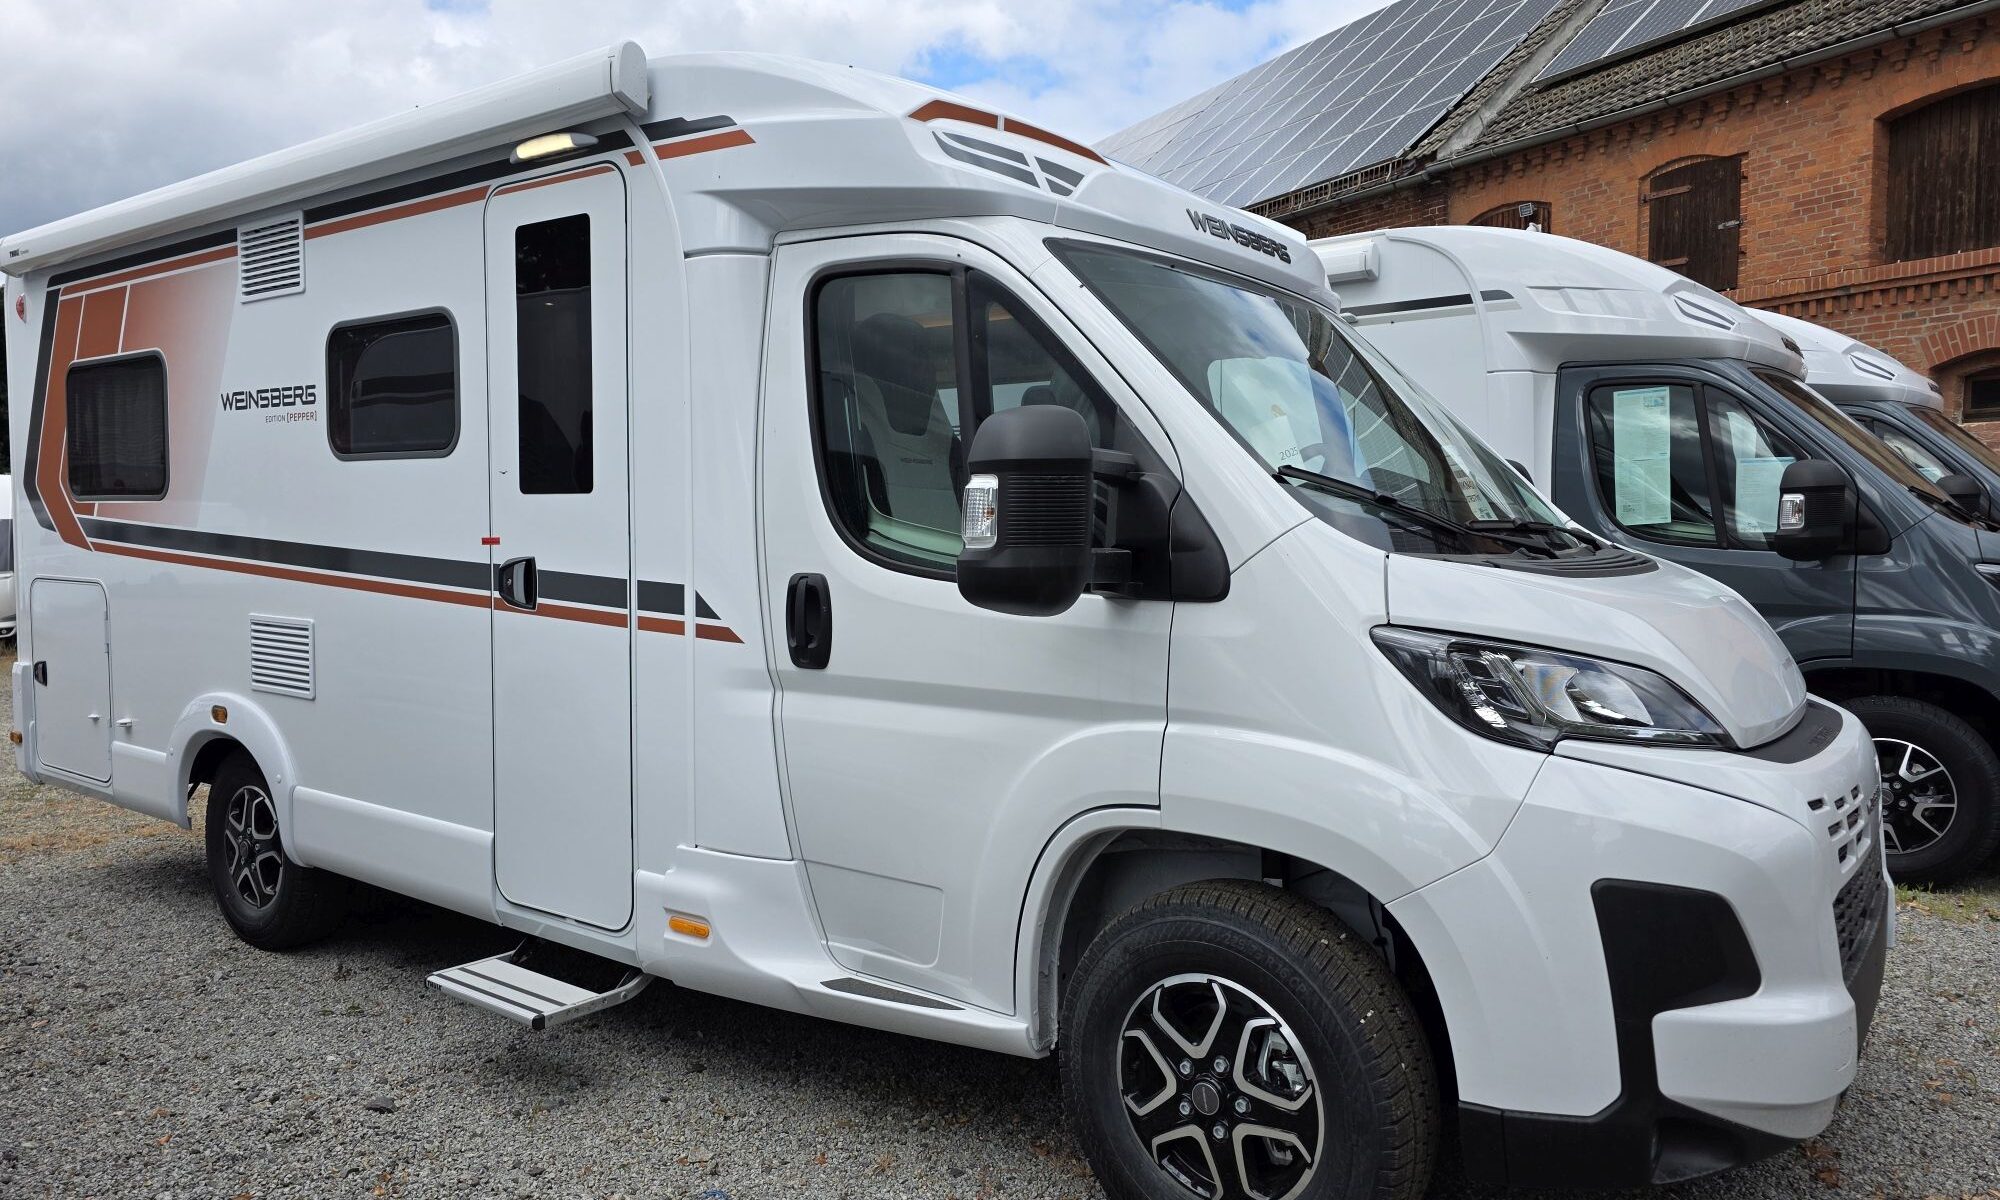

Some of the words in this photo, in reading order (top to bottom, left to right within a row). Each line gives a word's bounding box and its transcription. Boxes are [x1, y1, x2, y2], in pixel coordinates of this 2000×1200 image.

[1186, 208, 1292, 264] WEINSBERG
[220, 384, 317, 411] WEINSBERG
[265, 414, 286, 423] EDITION
[1280, 447, 1299, 460] 2025
